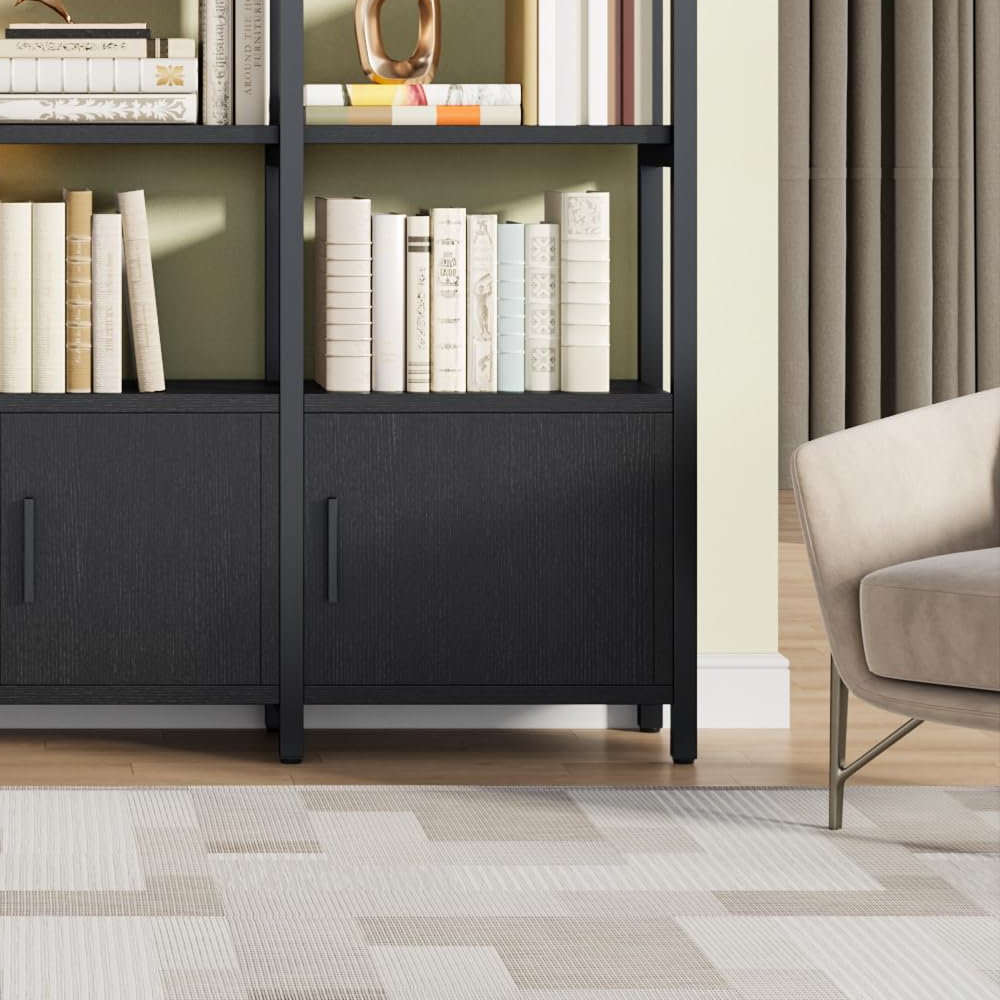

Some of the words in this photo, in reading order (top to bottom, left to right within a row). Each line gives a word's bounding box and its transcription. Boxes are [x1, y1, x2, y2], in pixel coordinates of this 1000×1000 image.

[244, 15, 252, 40] THE
[253, 0, 262, 68] FURNITURE
[244, 44, 252, 96] AROUND
